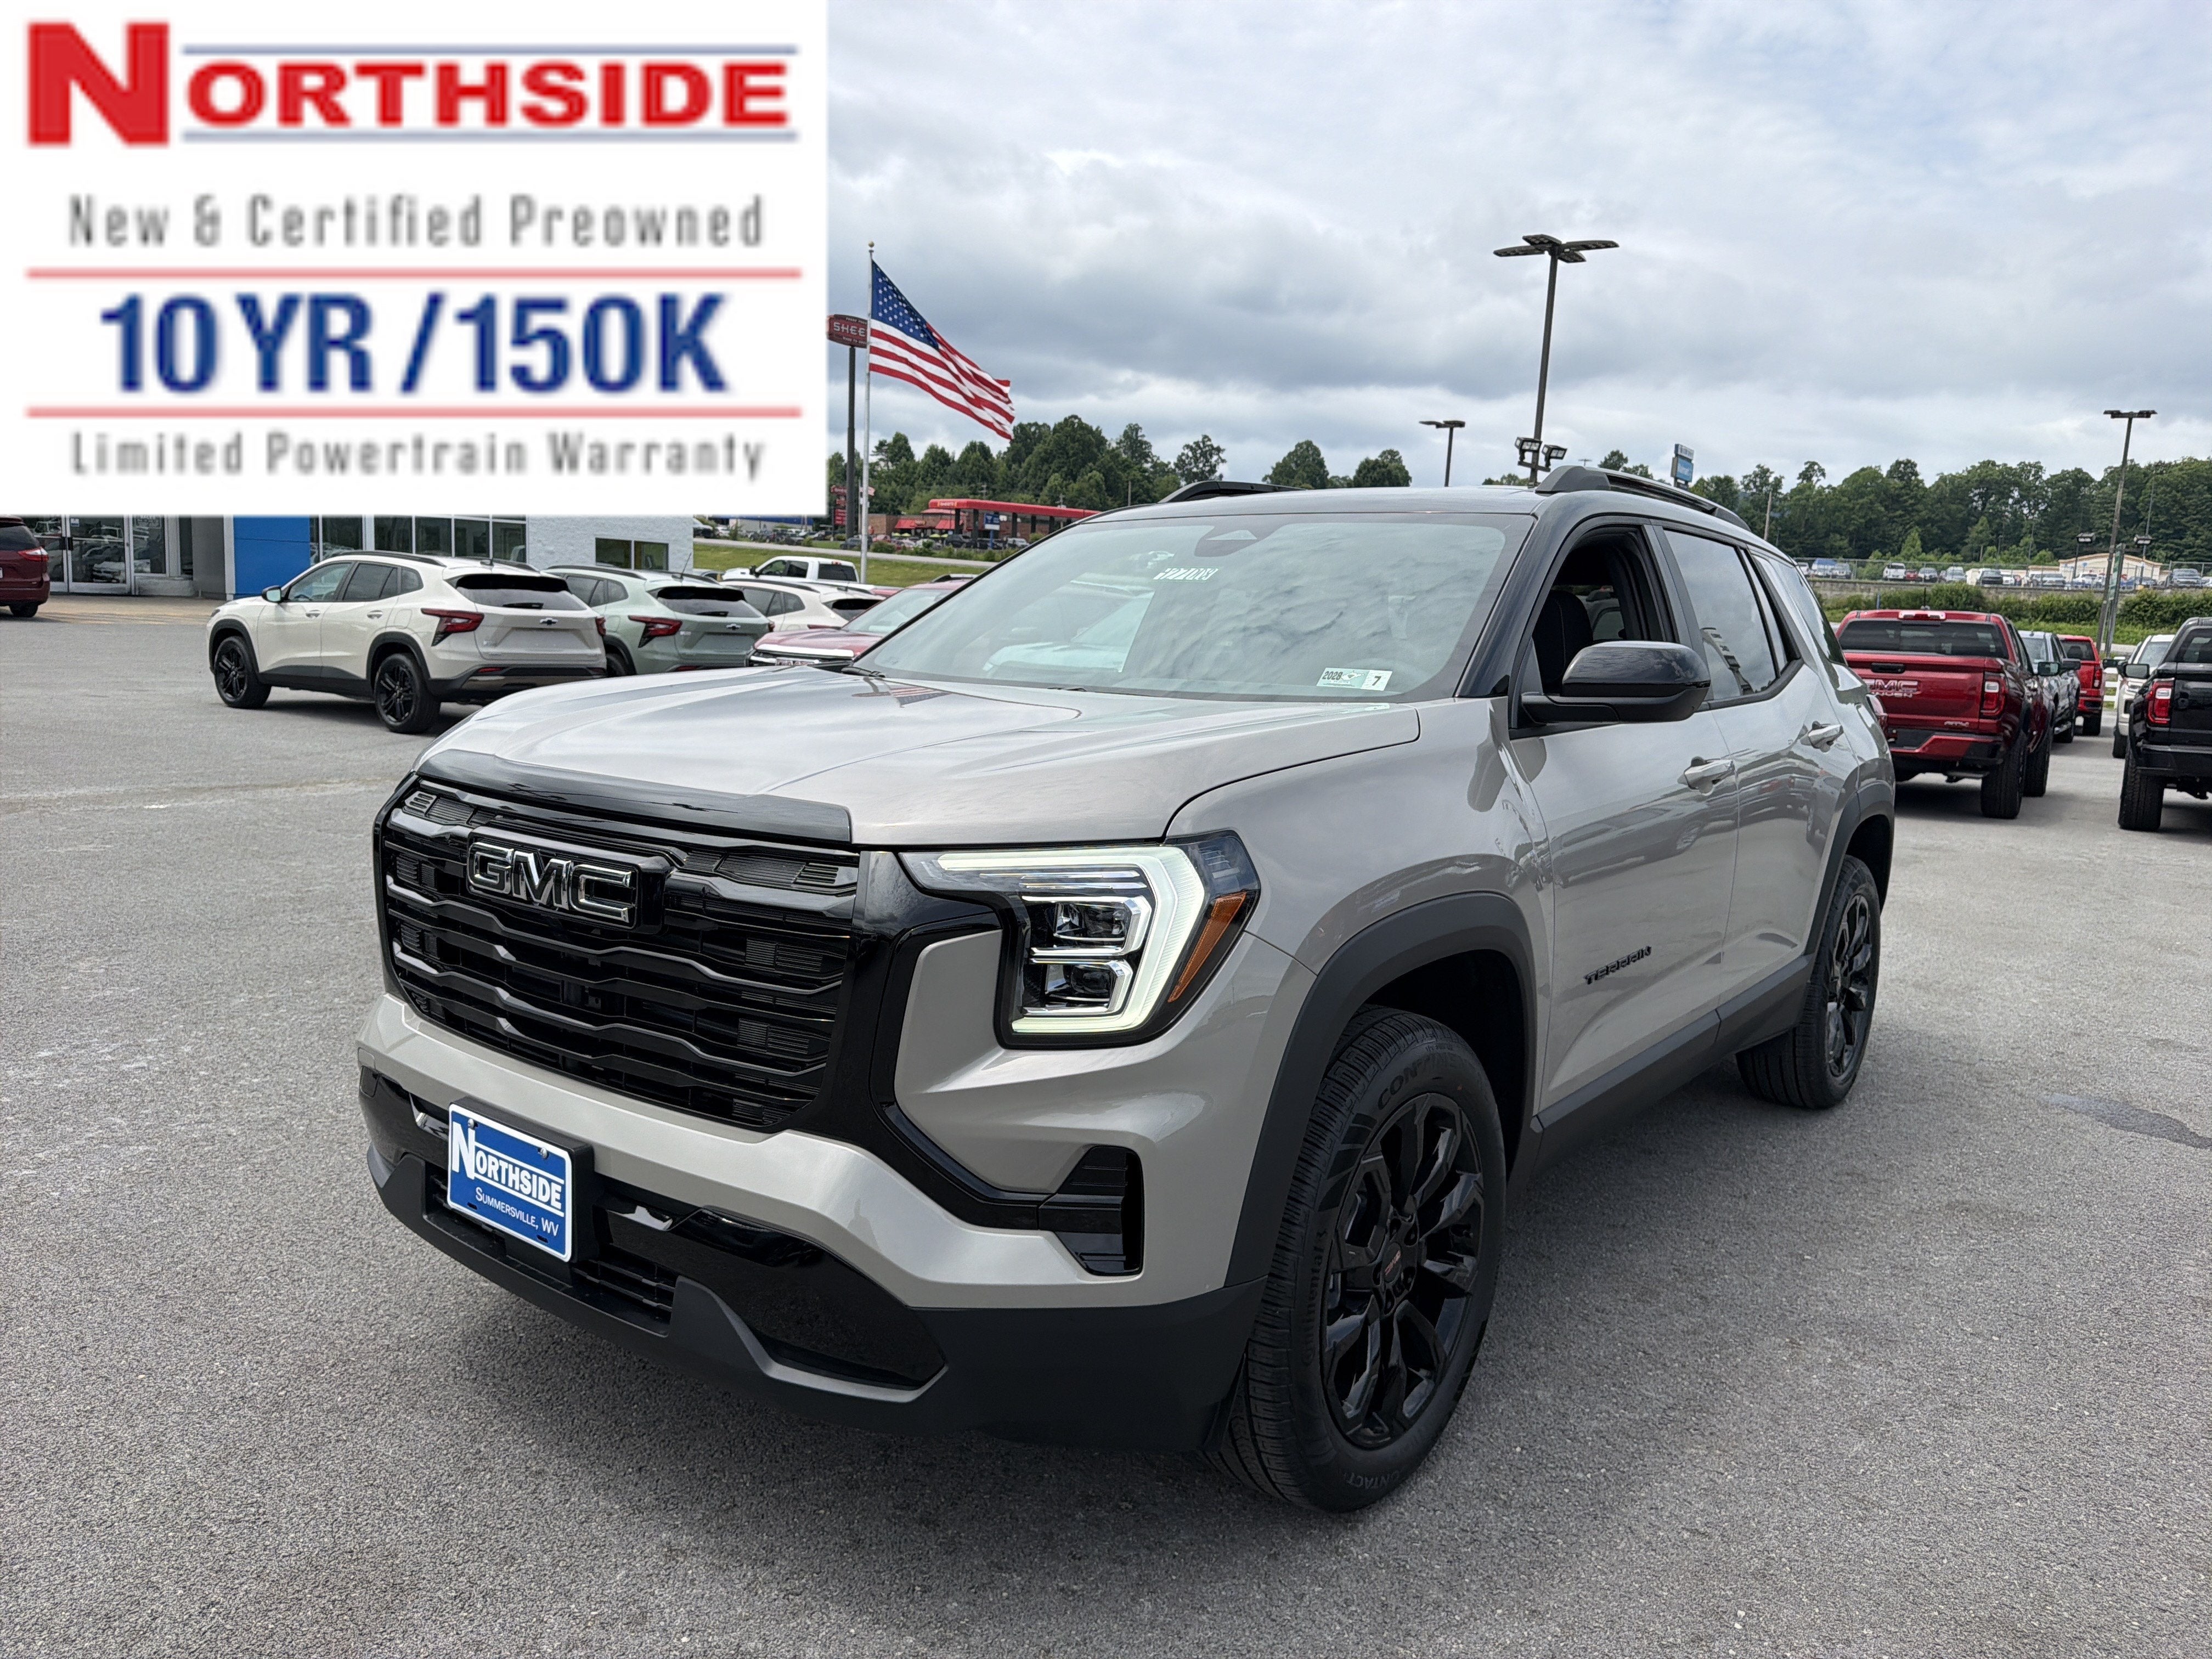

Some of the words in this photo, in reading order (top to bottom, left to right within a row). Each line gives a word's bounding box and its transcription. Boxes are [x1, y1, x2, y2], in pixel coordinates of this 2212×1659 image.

[833, 322, 866, 337] SHEE
[1322, 670, 1344, 681] 2028
[1372, 675, 1381, 686] 7
[468, 842, 632, 923] GMC
[1584, 946, 1651, 985] TERRAIN
[452, 1121, 562, 1210] NORTHSIDE
[475, 1187, 539, 1231] SUMMERSVILLE,
[541, 1217, 560, 1237] WV
